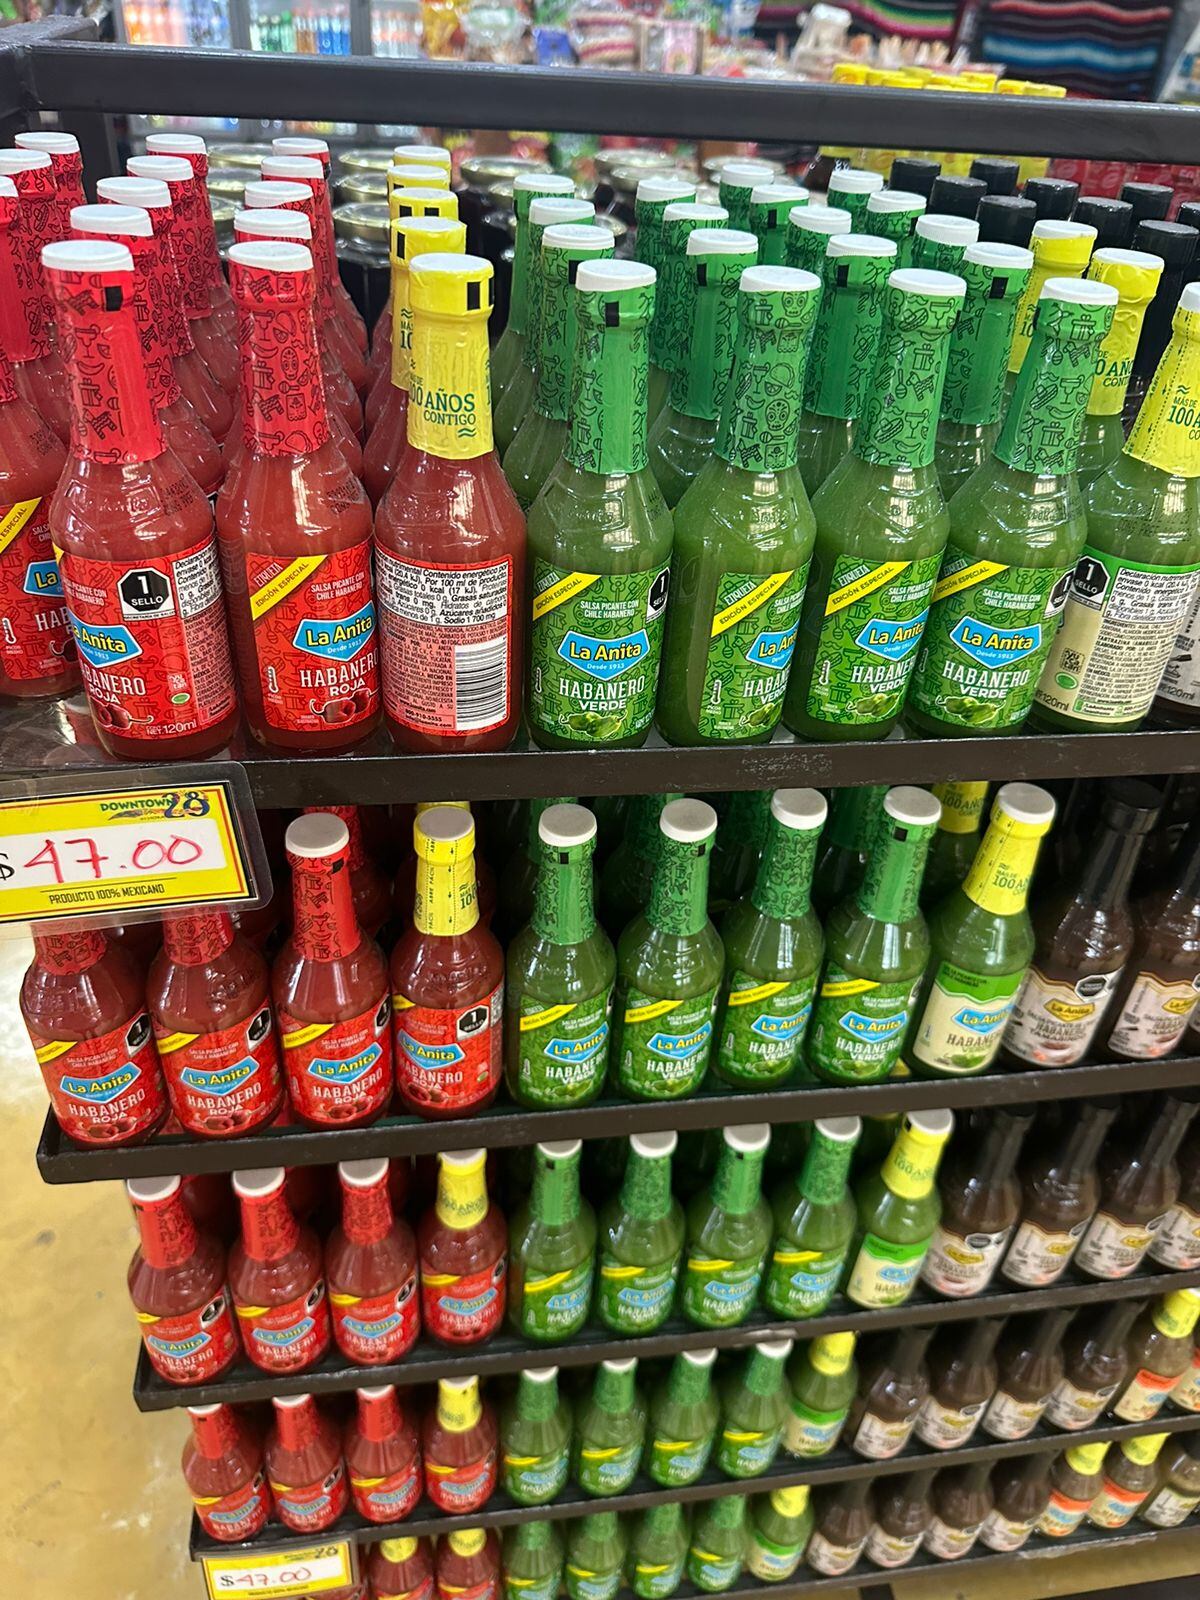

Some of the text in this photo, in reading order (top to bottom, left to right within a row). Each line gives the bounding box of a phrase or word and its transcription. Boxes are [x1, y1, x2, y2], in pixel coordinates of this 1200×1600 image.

[425, 388, 475, 414] AÑOS
[1189, 398, 1198, 408] DE
[423, 410, 476, 426] CONTIGO
[1167, 405, 1194, 428] 100
[2, 507, 27, 538] ESPECIAL
[35, 572, 57, 588] La
[253, 562, 283, 588] ETIQUETA
[423, 569, 461, 580] Contenido
[838, 564, 870, 587] ETIQUETA
[958, 566, 989, 583] ESPECIAL
[1086, 564, 1096, 581] 1
[1120, 569, 1160, 580] Declaración
[137, 575, 149, 595] 1
[255, 562, 309, 607] EDICIÓN ESPECIAL
[310, 571, 365, 593] SALSA PICANTE CON
[425, 577, 438, 586] Por
[441, 579, 454, 587] 100
[468, 579, 477, 587] de
[554, 578, 582, 598] ESPECIAL
[660, 575, 665, 593] 1
[832, 567, 894, 605] EDICIÓN ESPECIAL
[1062, 575, 1070, 592] 1
[1075, 579, 1098, 594] SELLO
[1116, 582, 1151, 594] Contenido
[1118, 577, 1143, 585] envase
[316, 582, 362, 600] CHILE HABANERO
[429, 585, 445, 593] kcal
[449, 587, 460, 596] (17
[451, 594, 477, 602] Grasas
[724, 580, 757, 605] ETIQUETA
[888, 586, 906, 596] SALSA
[982, 589, 1041, 602] SALSA PICANTE CON
[131, 595, 164, 606] SELLO
[413, 597, 436, 609] 0 mg.
[580, 600, 639, 610] SALSA PICANTE CON
[719, 579, 779, 625] EDICIÓN ESPECIAL
[984, 597, 1035, 610] CHILE HABANERO
[1131, 600, 1154, 608] Grasas
[425, 607, 430, 615] 0
[440, 608, 474, 617] Azúcares
[444, 616, 465, 624] Sodio
[472, 614, 484, 622] 700
[486, 613, 496, 621] mg
[584, 608, 635, 618] CHILE HABANERO
[306, 615, 373, 646] La Anita
[869, 627, 889, 645] La
[962, 627, 1034, 650] La Anita
[81, 627, 127, 654] Anita
[327, 644, 347, 654] Desde
[570, 642, 642, 662] La Anita
[759, 642, 776, 659] La
[976, 649, 997, 657] Desde
[300, 648, 379, 688] HABANERO
[587, 662, 607, 670] Desde
[942, 660, 1031, 689] HABANERO
[329, 679, 366, 697] ROJA
[559, 675, 645, 701] HABANERO
[870, 675, 906, 693] VERDE
[959, 684, 1009, 699] VERDE
[89, 684, 120, 705] ROJA
[1166, 686, 1195, 700] 120ml
[579, 700, 627, 711] VERDE
[1042, 693, 1069, 711] 120ml
[164, 719, 197, 734] 120ml
[100, 799, 175, 811] DOWNTOWN
[162, 791, 210, 818] 28
[0, 834, 204, 884] $ 47.00
[992, 875, 1016, 889] 100
[49, 883, 165, 905] PRODUCTO 100% MEXICANO
[470, 1011, 477, 1023] 1
[1064, 1006, 1091, 1014] Anita
[761, 1021, 778, 1032] La
[849, 1018, 901, 1033] La Anita
[962, 1013, 978, 1025] La
[554, 1045, 571, 1055] La
[657, 1039, 672, 1050] La
[417, 1046, 455, 1060] Anita
[316, 1052, 376, 1075] La Anita
[67, 1072, 133, 1093] La Anita
[188, 1066, 250, 1085] La Anita
[313, 1067, 382, 1098] HABANERO
[69, 1088, 146, 1117] HABANERO
[187, 1081, 262, 1109] HABANERO
[334, 1091, 367, 1105] ROJA
[92, 1112, 128, 1124] ROJA
[209, 1104, 243, 1116] ROJA
[220, 1575, 234, 1587] $
